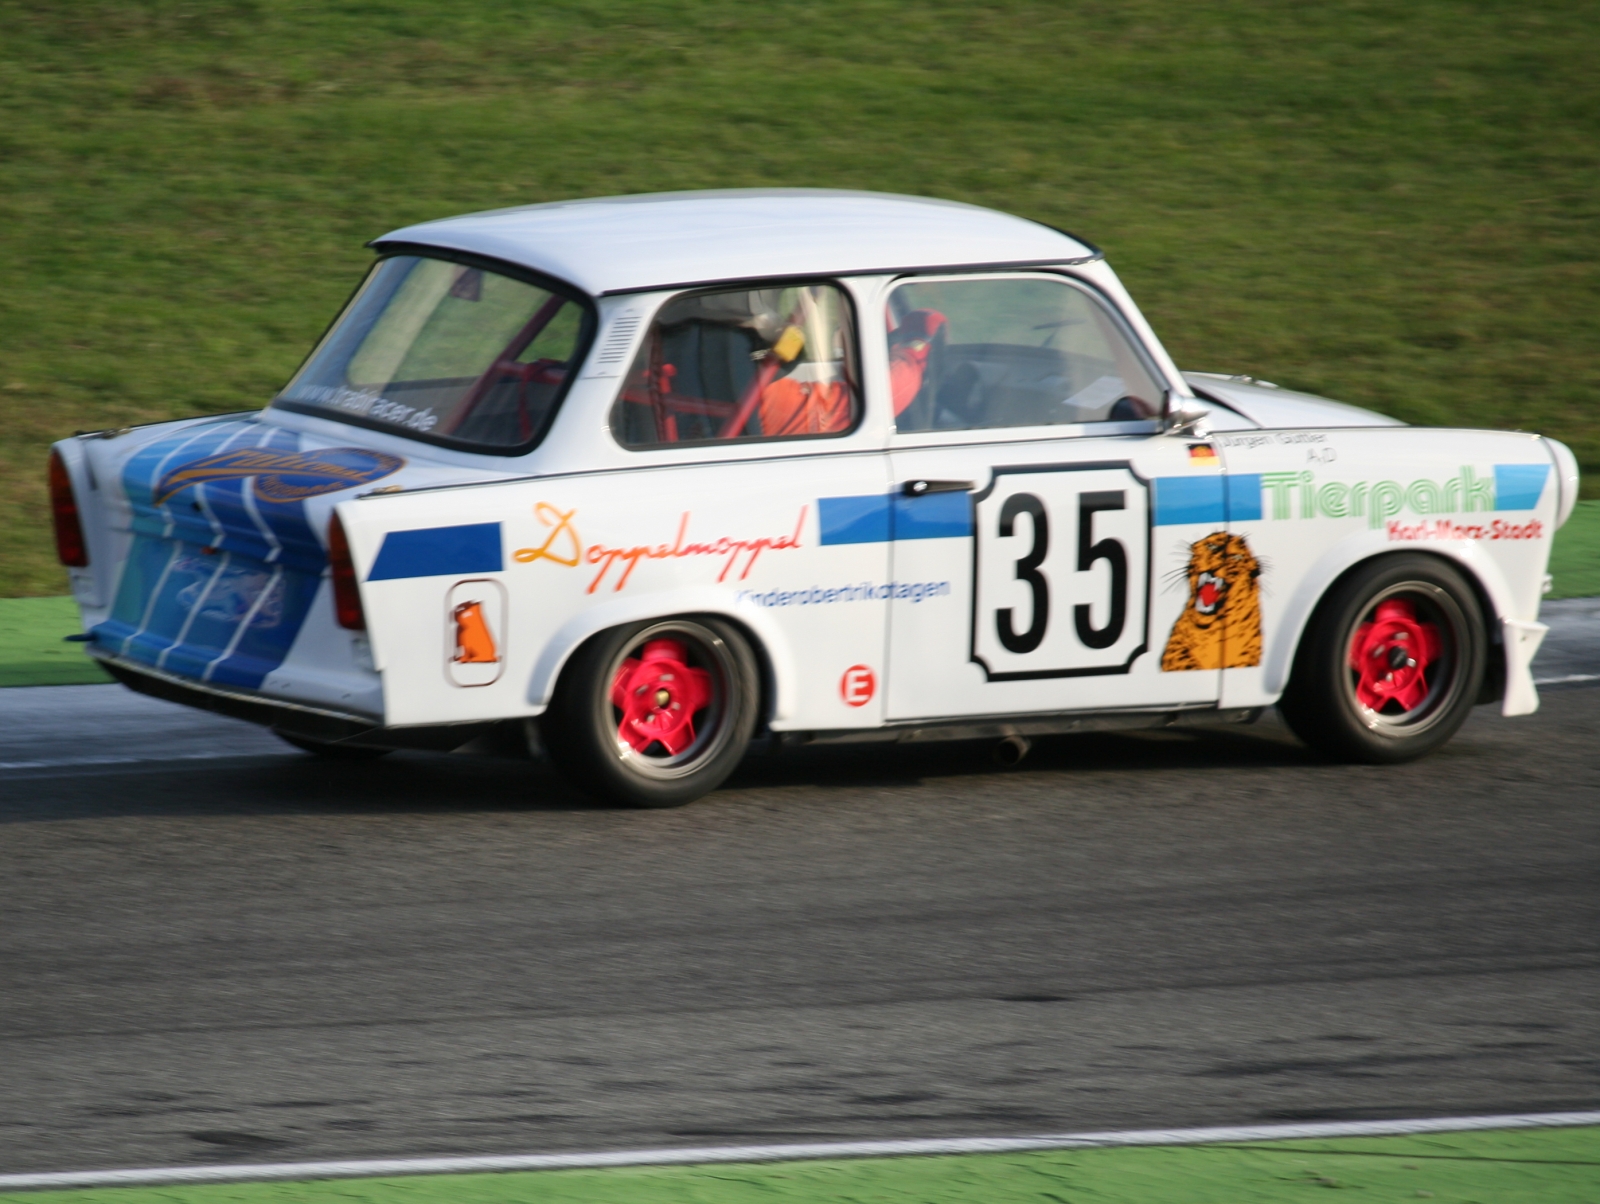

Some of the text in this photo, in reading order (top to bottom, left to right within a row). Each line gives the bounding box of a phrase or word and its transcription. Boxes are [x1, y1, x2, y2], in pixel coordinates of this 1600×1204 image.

[1261, 465, 1494, 530] Tierpark
[1387, 519, 1543, 541] Karl-Marx-Stadt
[512, 501, 809, 595] Doppelmoppel
[995, 489, 1128, 654] 35
[848, 670, 870, 701] E
